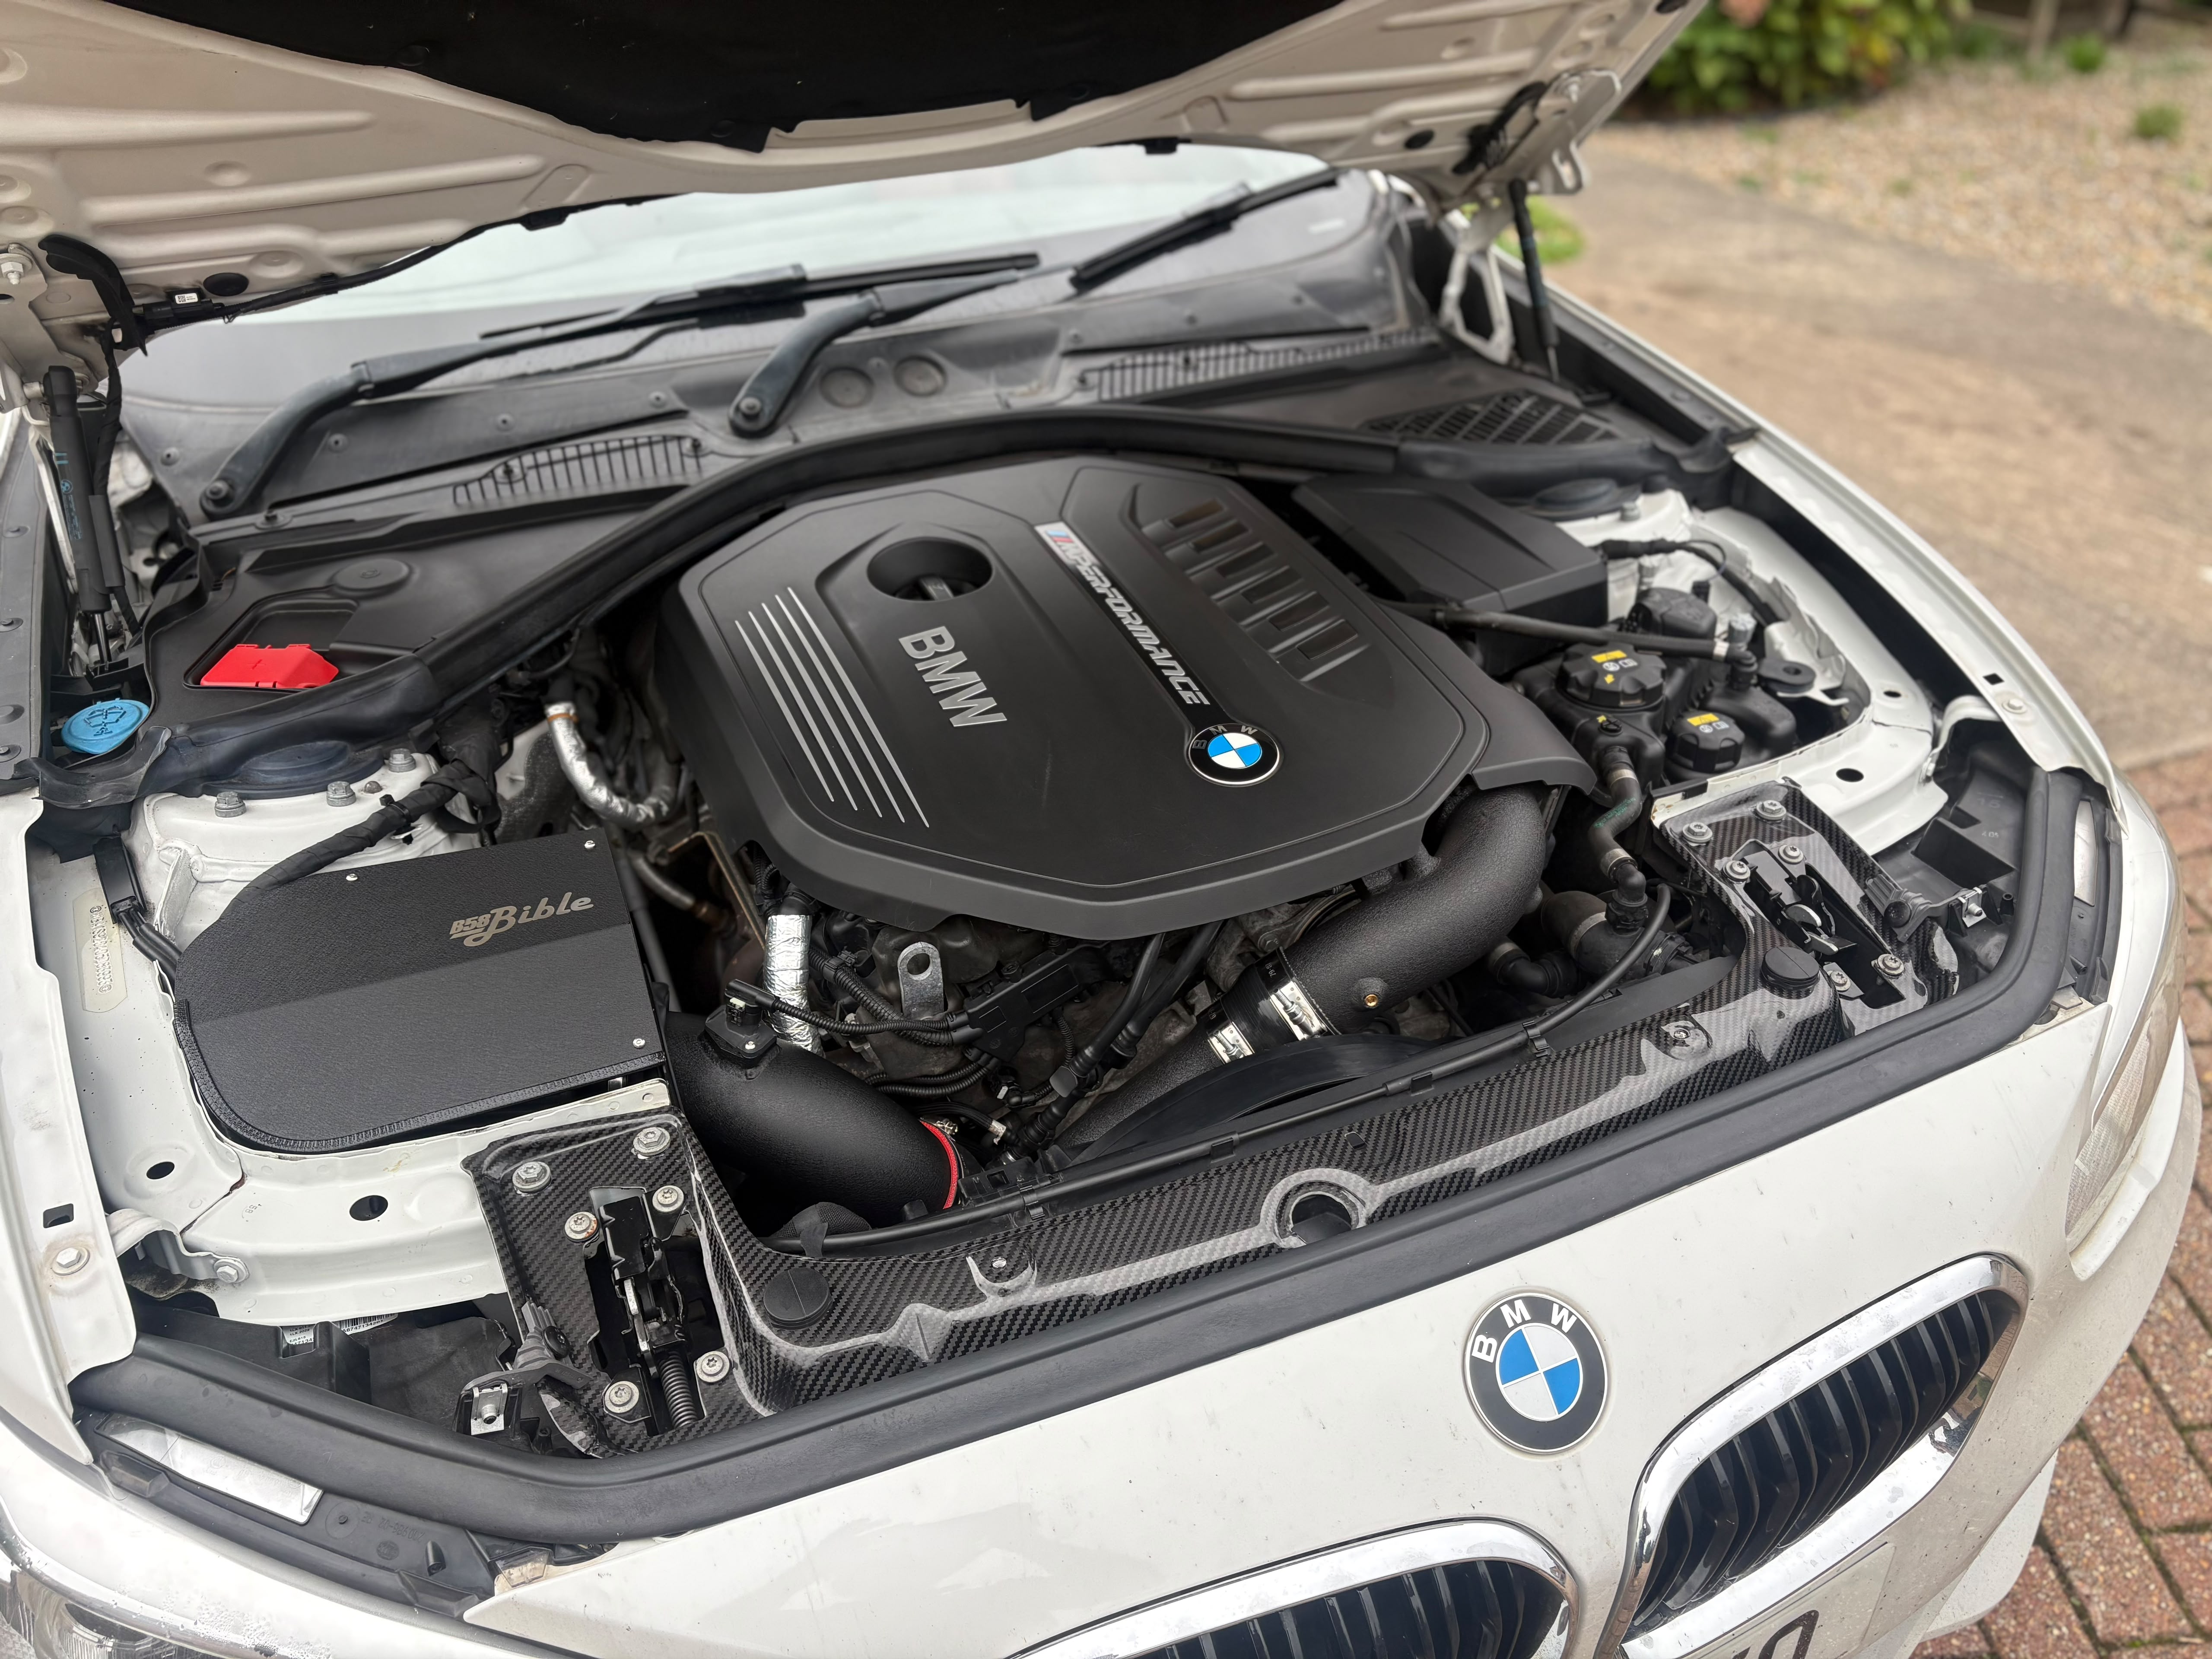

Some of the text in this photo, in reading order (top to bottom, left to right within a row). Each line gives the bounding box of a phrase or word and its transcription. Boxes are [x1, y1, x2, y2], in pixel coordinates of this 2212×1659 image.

[1075, 553, 1211, 705] PERFORMANCE
[899, 626, 1007, 727] BMW
[1192, 725, 1258, 749] BMW
[449, 892, 594, 947] B58 Bible
[1471, 1299, 1577, 1363] BMW
